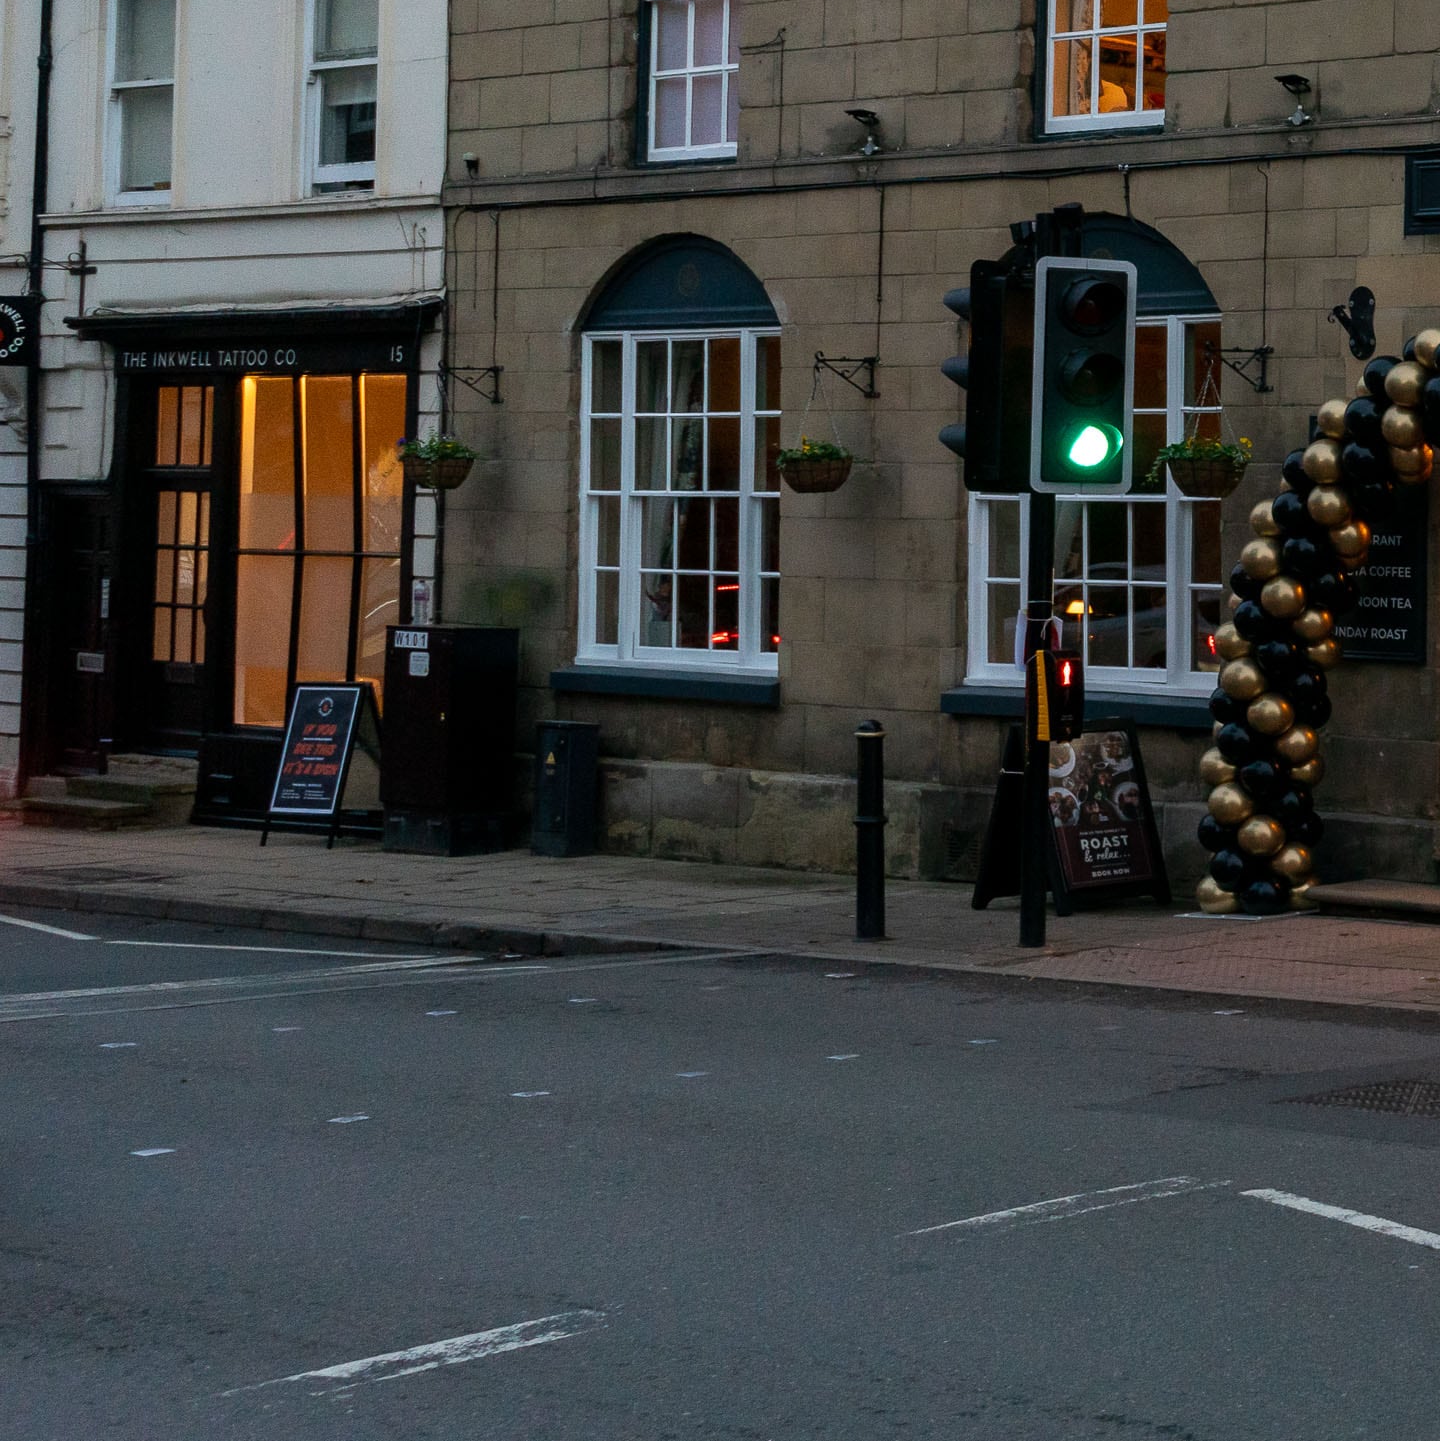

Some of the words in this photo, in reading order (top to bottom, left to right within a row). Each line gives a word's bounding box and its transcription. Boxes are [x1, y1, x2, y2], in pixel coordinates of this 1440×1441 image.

[123, 351, 147, 367] THE
[153, 350, 212, 367] INKWELL
[218, 349, 268, 366] TATTOO
[274, 348, 298, 365] CO.
[391, 345, 403, 363] 15
[1369, 566, 1412, 578] COFFEE
[1391, 597, 1412, 609] TEA
[1370, 627, 1408, 640] ROAST
[1080, 835, 1129, 850] ROAST
[1091, 869, 1112, 877] BOOK
